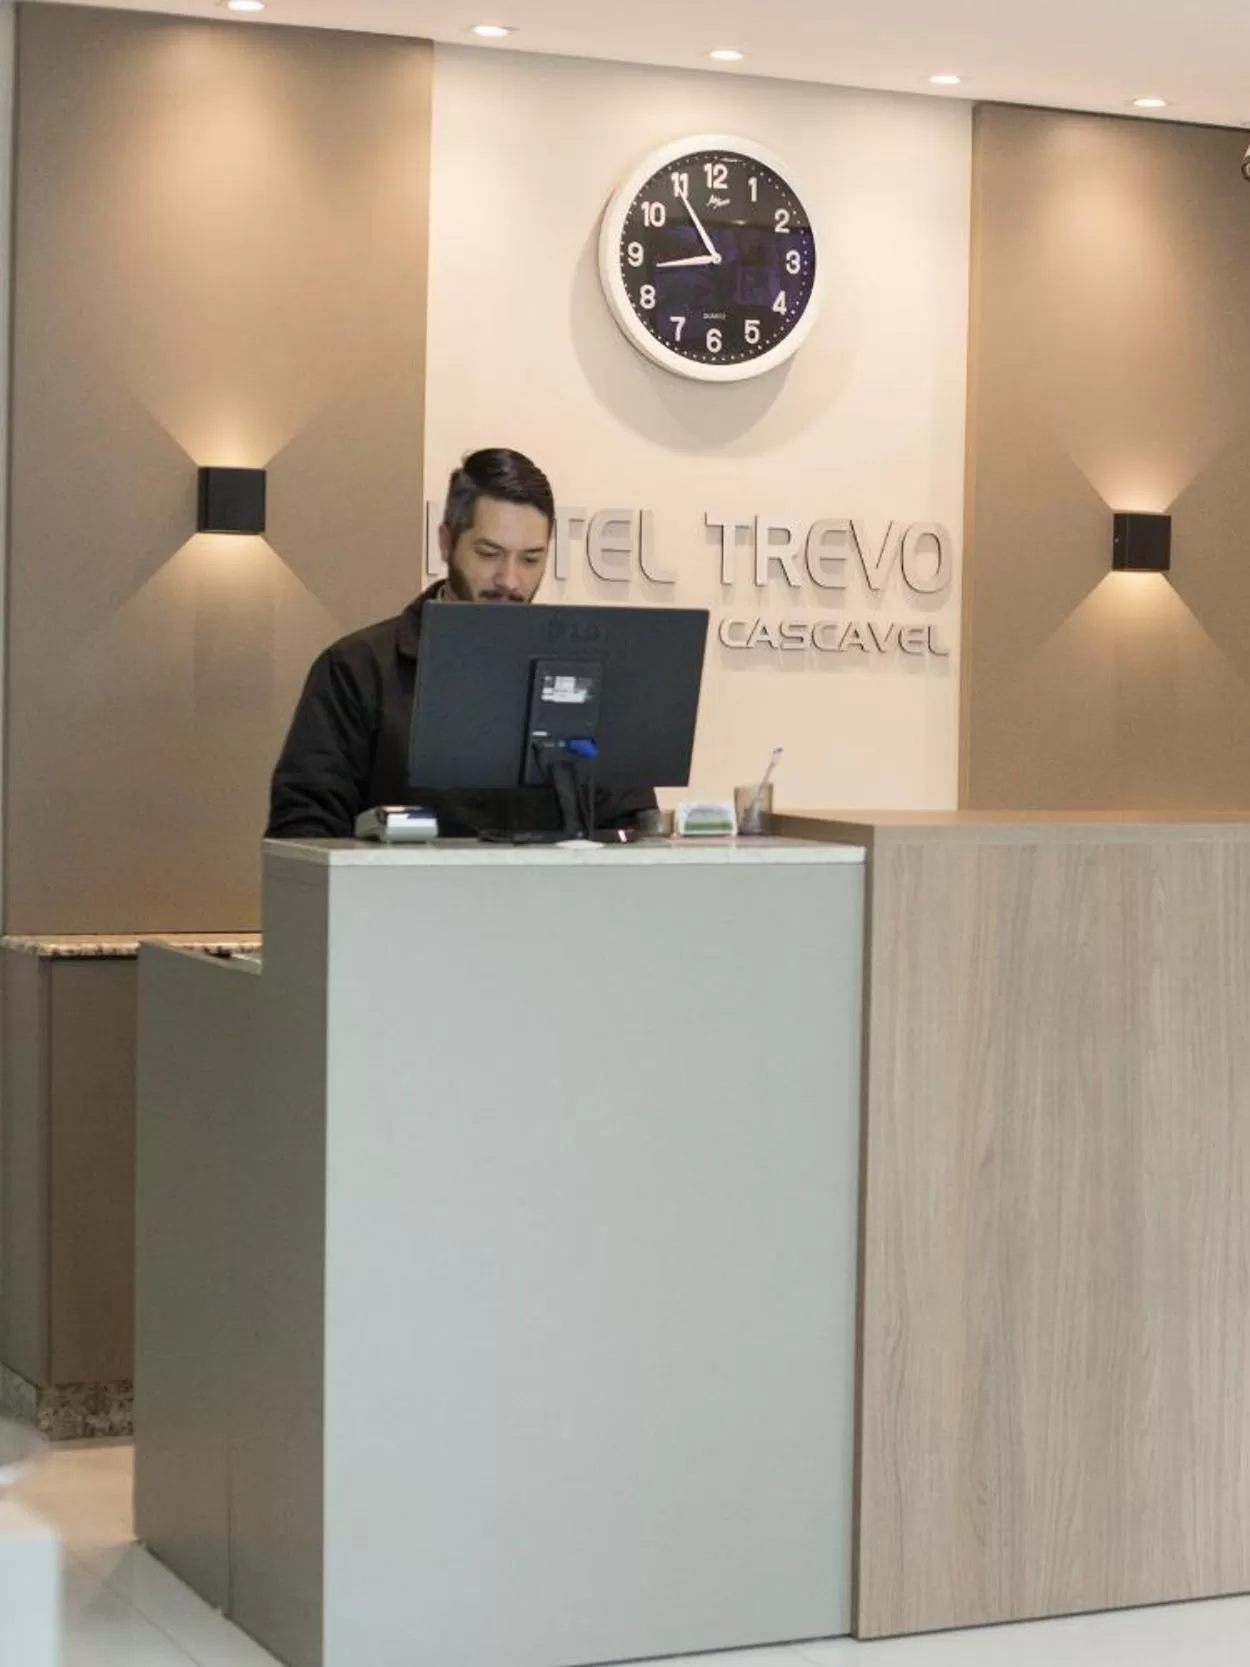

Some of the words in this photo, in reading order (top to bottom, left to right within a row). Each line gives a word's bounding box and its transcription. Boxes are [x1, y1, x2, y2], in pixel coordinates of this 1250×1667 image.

[671, 172, 689, 198] 11
[704, 163, 729, 189] 12
[748, 177, 758, 202] 1
[641, 201, 666, 227] 10
[774, 209, 790, 233] 2
[627, 241, 644, 267] 9
[786, 250, 801, 274] 3
[640, 285, 656, 309] 8
[772, 291, 787, 315] 4
[670, 316, 686, 341] 7
[706, 328, 722, 353] 6
[744, 319, 760, 344] 5
[426, 501, 679, 584] TEL
[704, 512, 951, 593] TREVO
[718, 617, 949, 656] CASCAVEL
